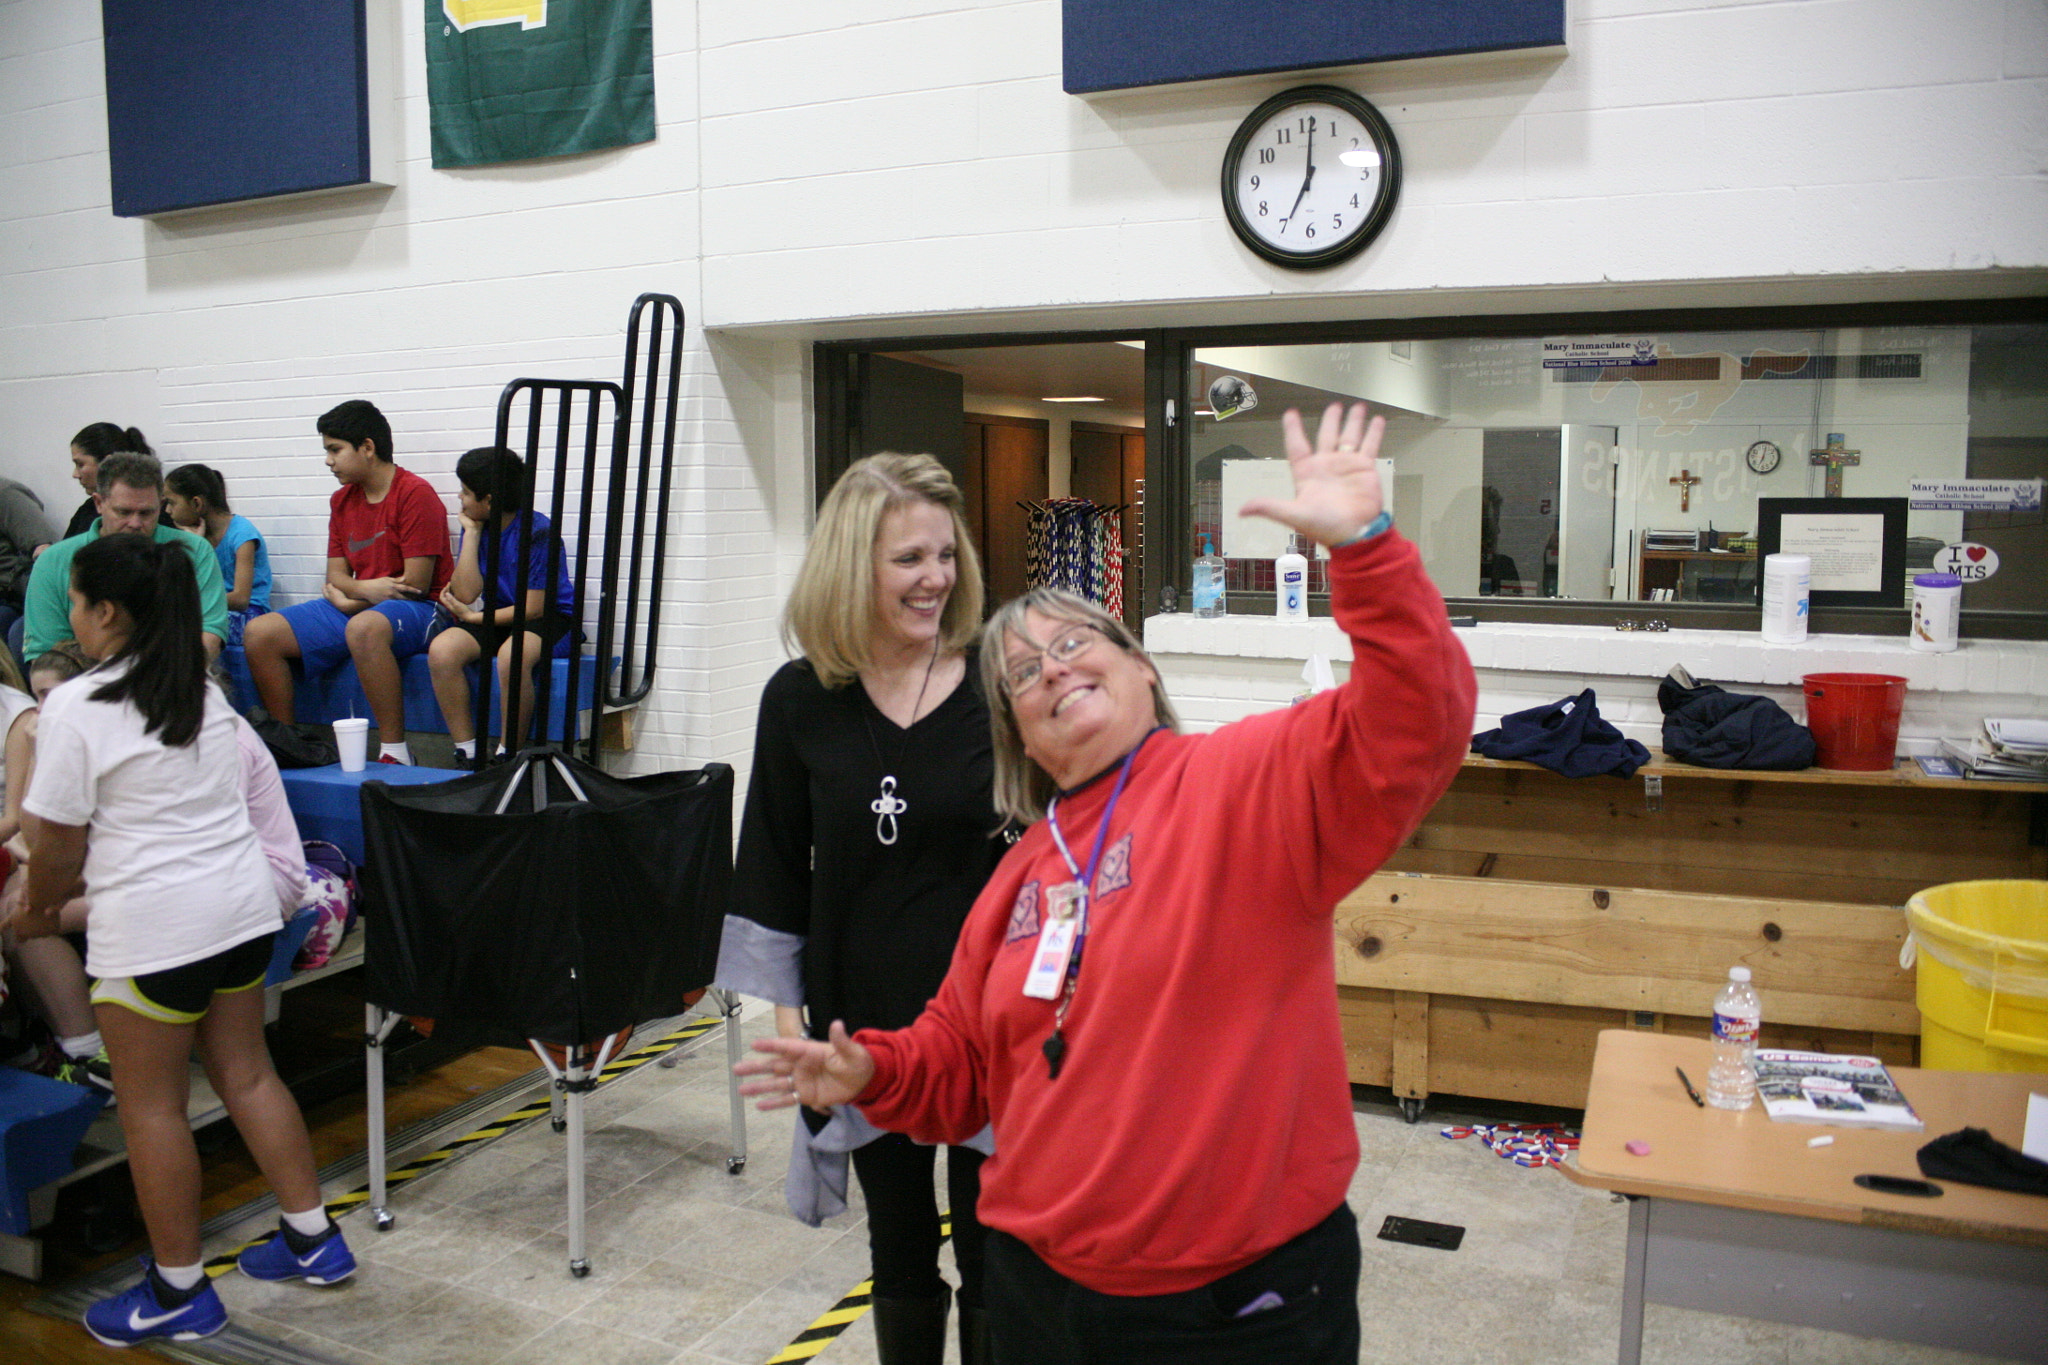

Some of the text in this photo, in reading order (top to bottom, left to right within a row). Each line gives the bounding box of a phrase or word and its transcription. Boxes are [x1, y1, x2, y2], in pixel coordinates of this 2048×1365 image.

[1298, 116, 1317, 134] 12
[1330, 121, 1338, 137] 1
[1276, 128, 1291, 145] 11
[1351, 137, 1360, 151] 2
[1258, 147, 1275, 164] 10
[1360, 167, 1370, 181] 3
[1250, 175, 1260, 191] 9
[1258, 200, 1268, 217] 8
[1349, 193, 1359, 208] 4
[1278, 218, 1288, 234] 7
[1332, 213, 1342, 230] 5
[1305, 222, 1315, 238] 6
[1544, 341, 1632, 352] Mary Immaculate
[1912, 484, 2010, 493] Mary Immaculate
[1948, 546, 1962, 563] I
[1948, 565, 1986, 579] MIS
